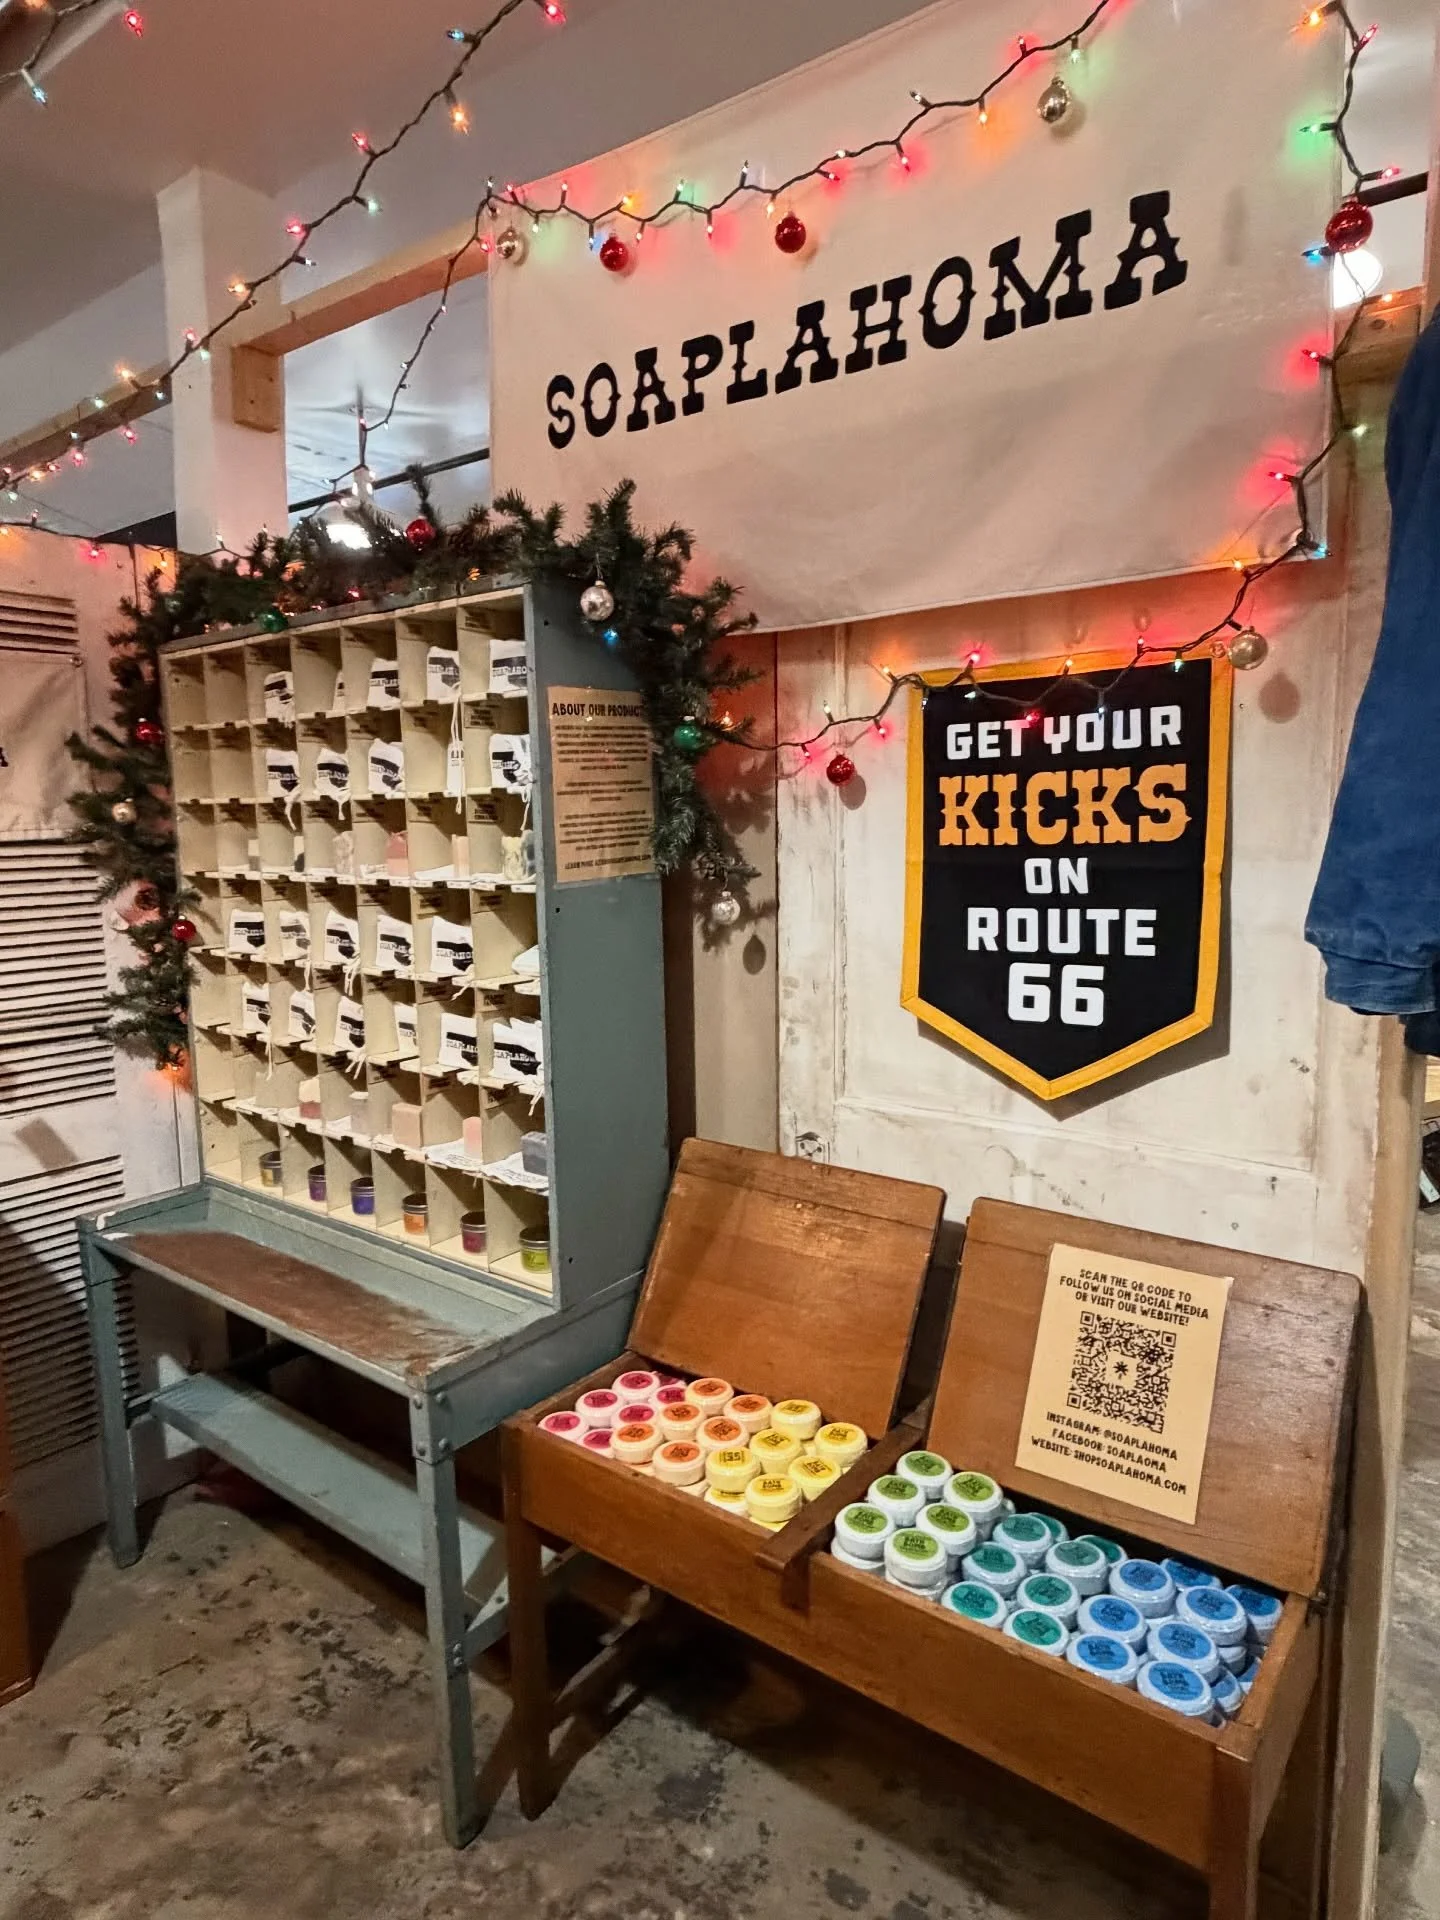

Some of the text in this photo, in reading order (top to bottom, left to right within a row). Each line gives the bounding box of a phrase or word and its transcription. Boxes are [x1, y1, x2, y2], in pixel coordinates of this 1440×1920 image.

[547, 190, 1188, 450] SOAPLAHOMA
[552, 703, 585, 716] ABOUT
[588, 704, 605, 716] OUR
[946, 705, 1181, 760] GET YOUR
[939, 764, 1192, 846] KICKS
[1024, 857, 1089, 895] ON
[967, 907, 1157, 956] ROUTE
[1008, 962, 1105, 1026] 66
[1060, 1275, 1209, 1320] FOLLOW US ON SOCIAL MEDIA
[1075, 1291, 1190, 1327] OR VISIT OUR WEBSITE!
[1079, 1268, 1192, 1303] SCAN THE QR CODE TO
[1046, 1411, 1178, 1461] INSTAGRAM: @SOAPLAHOMA
[1052, 1428, 1167, 1473] FACEBOOK: SOAPLAOMA
[1031, 1435, 1187, 1495] WEBSITE: SHOPSOAPLAHOMA.COM
